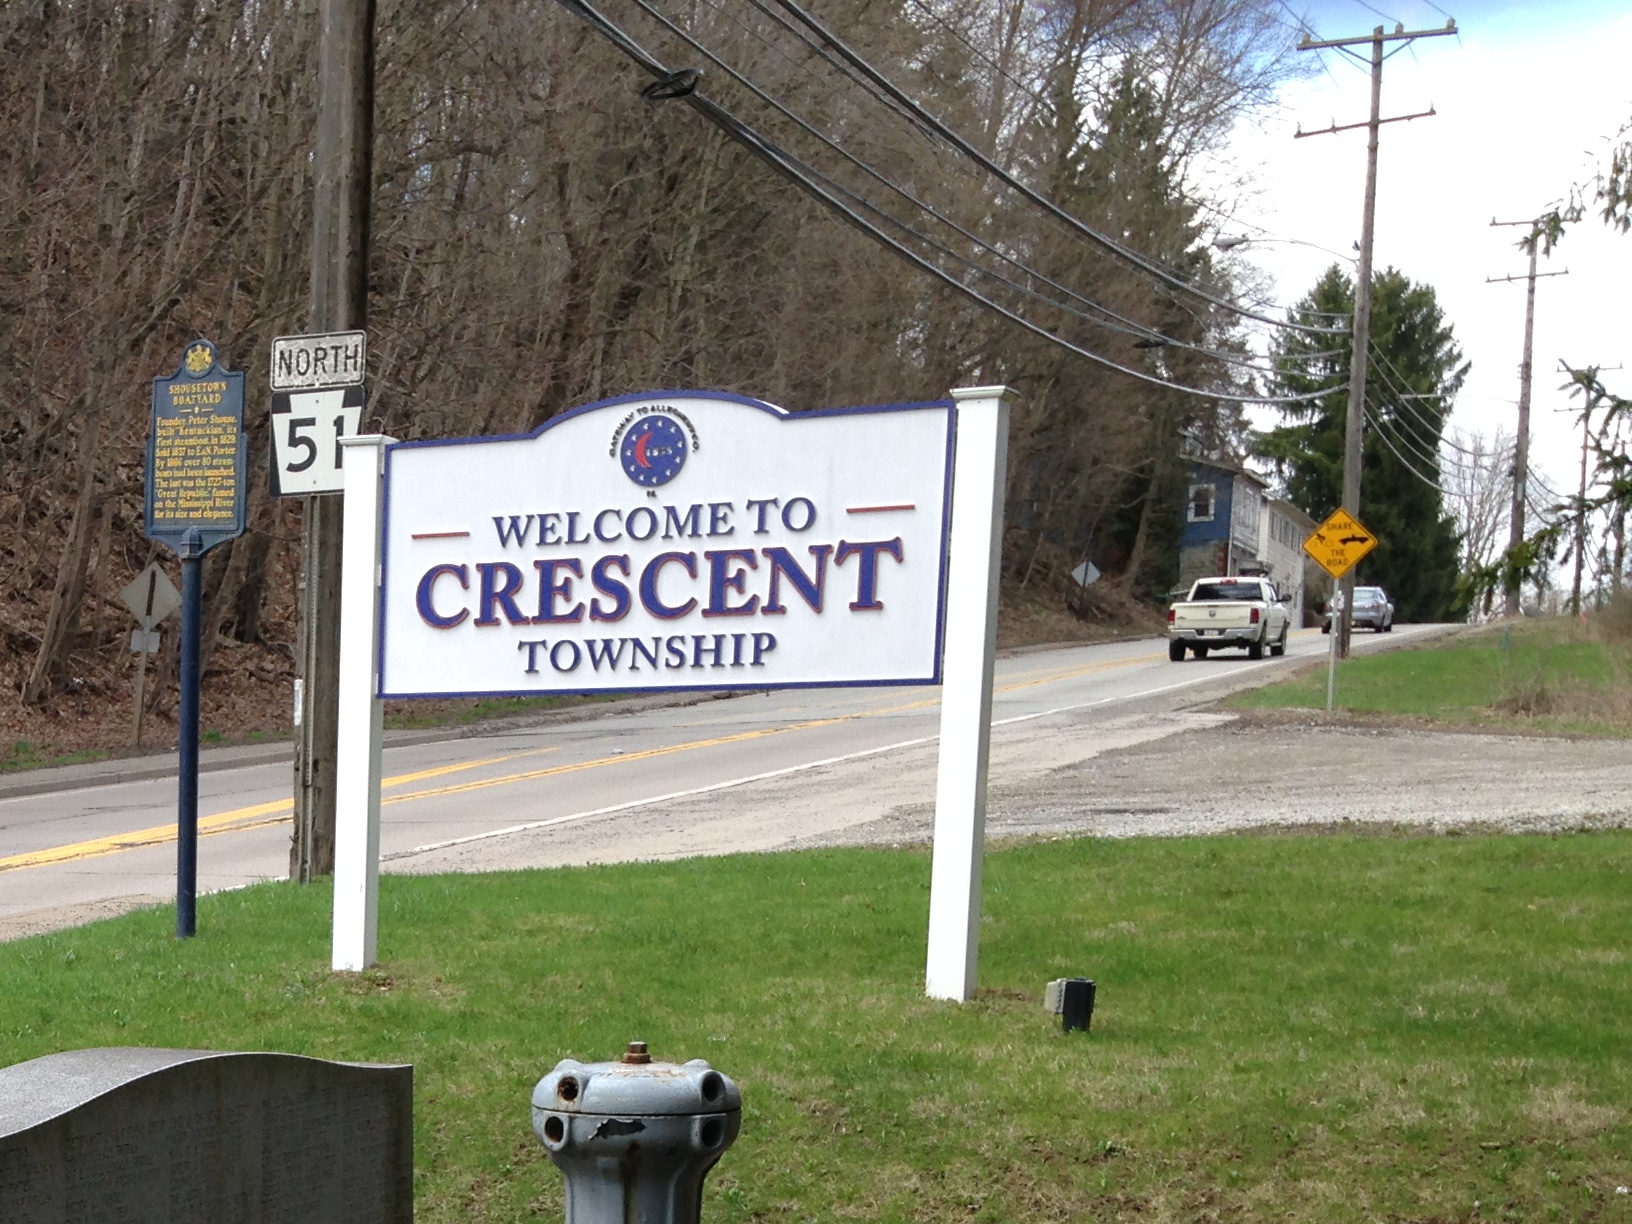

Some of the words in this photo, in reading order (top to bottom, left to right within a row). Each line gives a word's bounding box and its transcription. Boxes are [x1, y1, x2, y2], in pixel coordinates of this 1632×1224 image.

[278, 344, 359, 378] NORTH
[169, 382, 227, 394] SHOUSETOWN
[173, 393, 221, 406] BOATYARD
[636, 406, 649, 416] TO
[188, 415, 208, 425] Peter
[286, 415, 344, 473] 51
[187, 448, 195, 456] to
[156, 458, 165, 469] By
[155, 479, 168, 488] The
[169, 479, 182, 487] last
[195, 478, 206, 487] the
[165, 500, 176, 508] the
[492, 502, 735, 548] WELCOME
[746, 497, 817, 534] TO
[1326, 522, 1353, 531] SHARE
[1331, 548, 1345, 556] THE
[1326, 558, 1349, 567] ROAD
[416, 537, 904, 629] CRESCENT
[517, 632, 778, 674] TOWNSHIP
